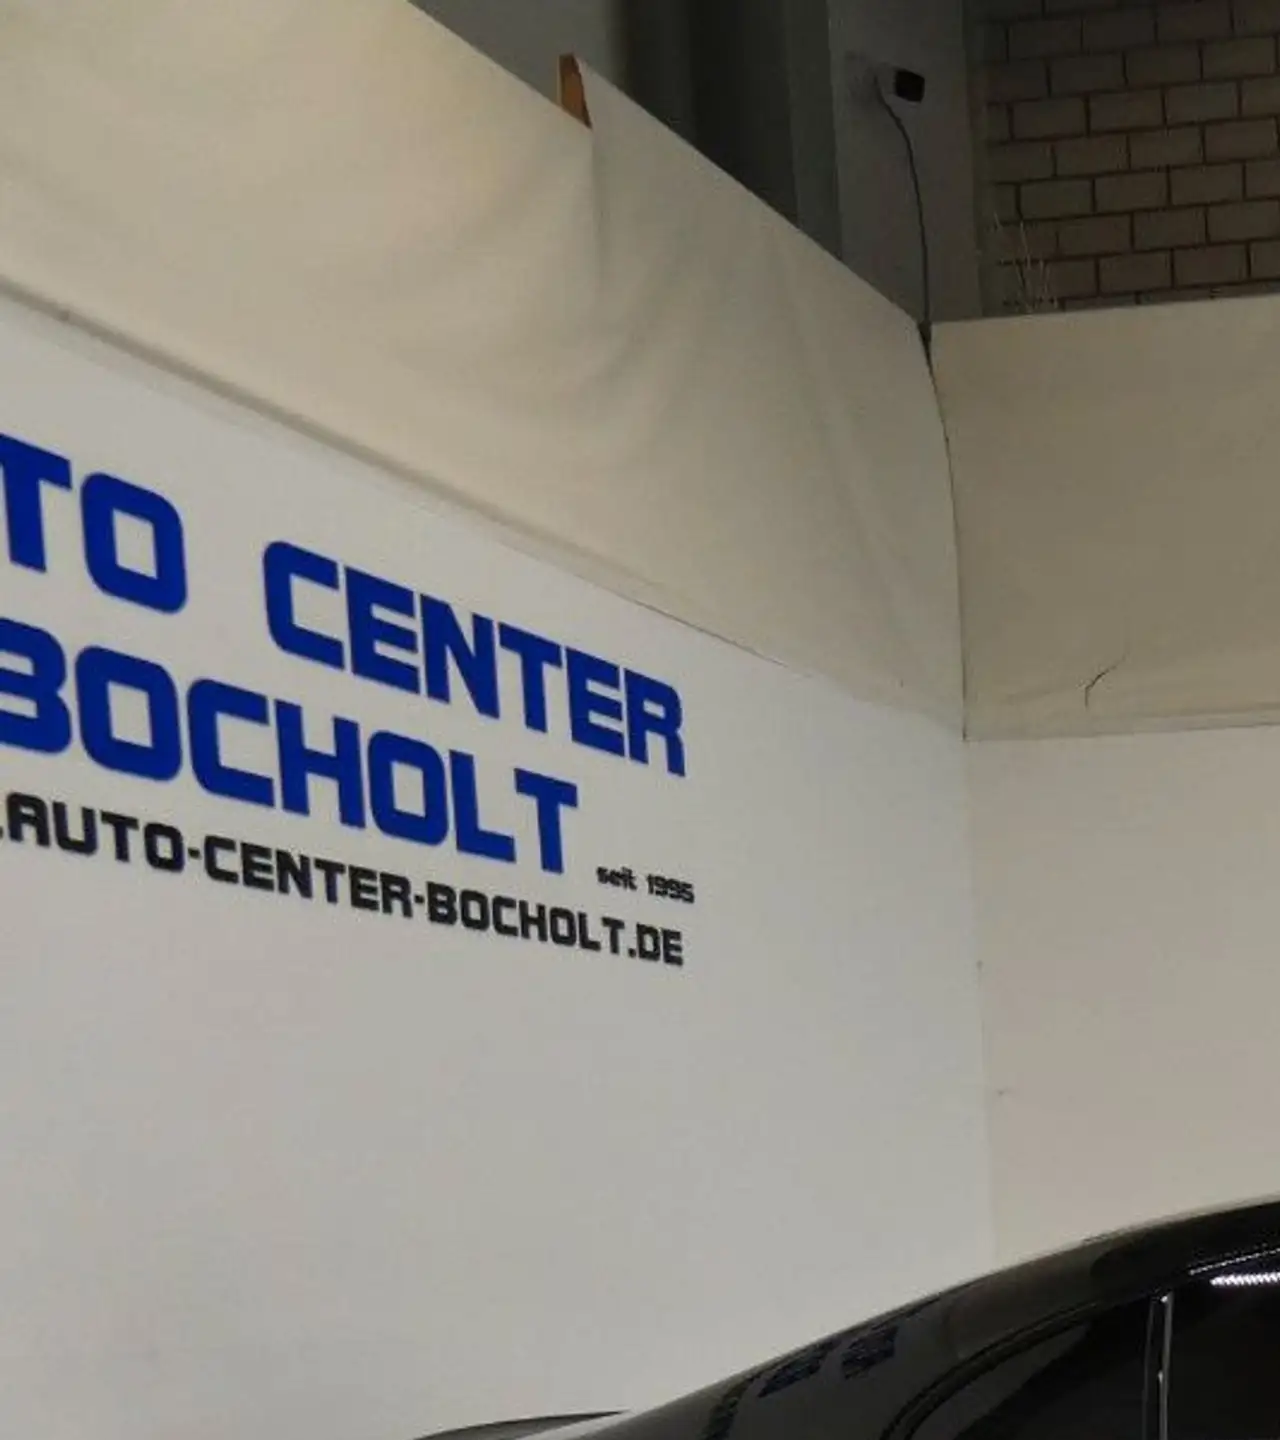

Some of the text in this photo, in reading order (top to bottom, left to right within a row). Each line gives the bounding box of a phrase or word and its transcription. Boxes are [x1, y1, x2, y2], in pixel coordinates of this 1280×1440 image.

[0, 617, 579, 875] BOCHOLT
[262, 540, 686, 778] CENTER
[596, 866, 695, 904] seit 1995
